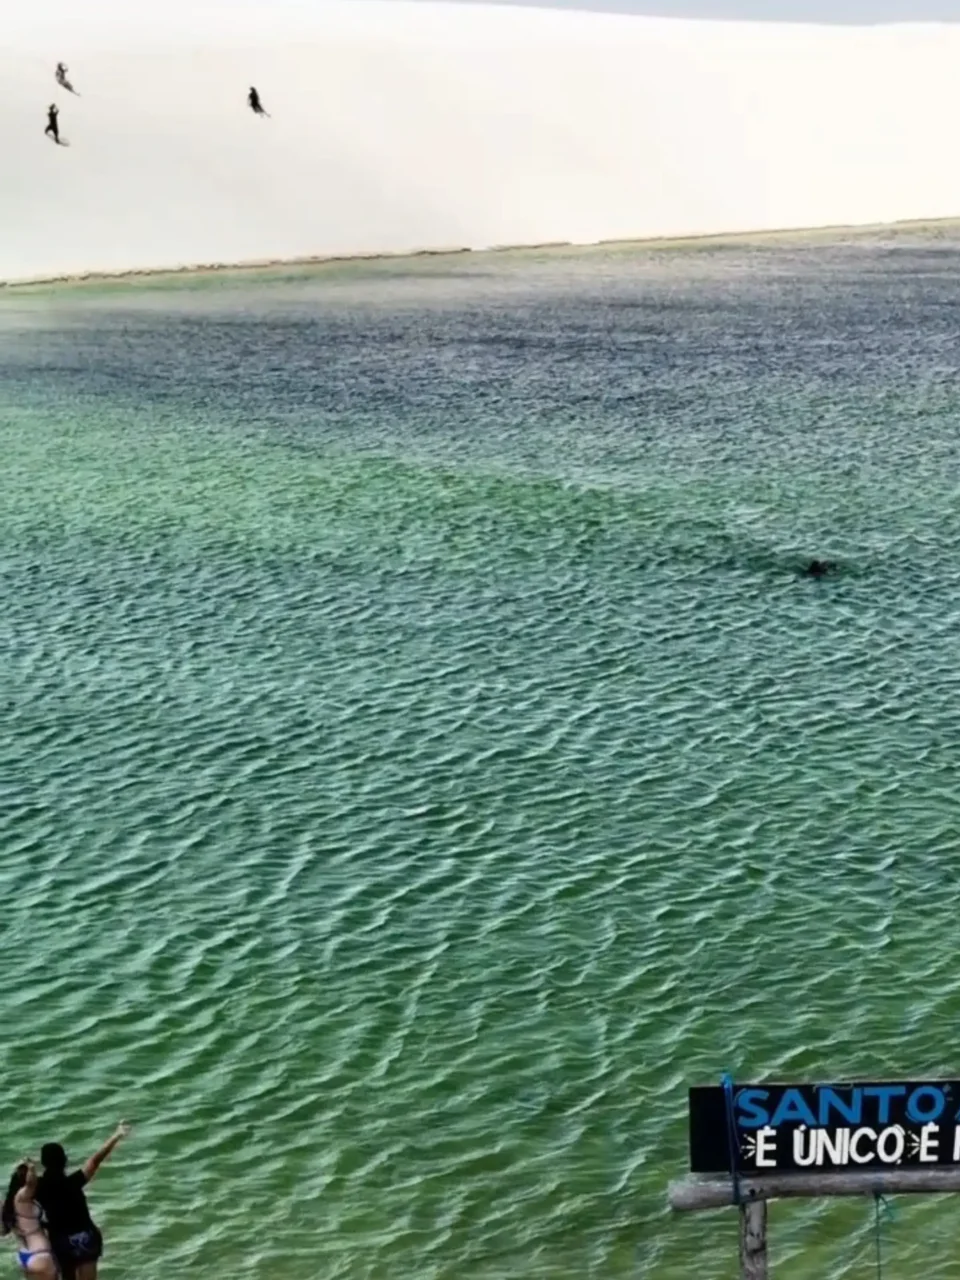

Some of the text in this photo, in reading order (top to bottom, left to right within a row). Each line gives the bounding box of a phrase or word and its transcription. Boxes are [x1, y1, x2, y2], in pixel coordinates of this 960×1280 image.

[735, 1085, 946, 1128] SANTO
[755, 1125, 777, 1167] É
[919, 1121, 940, 1163] É
